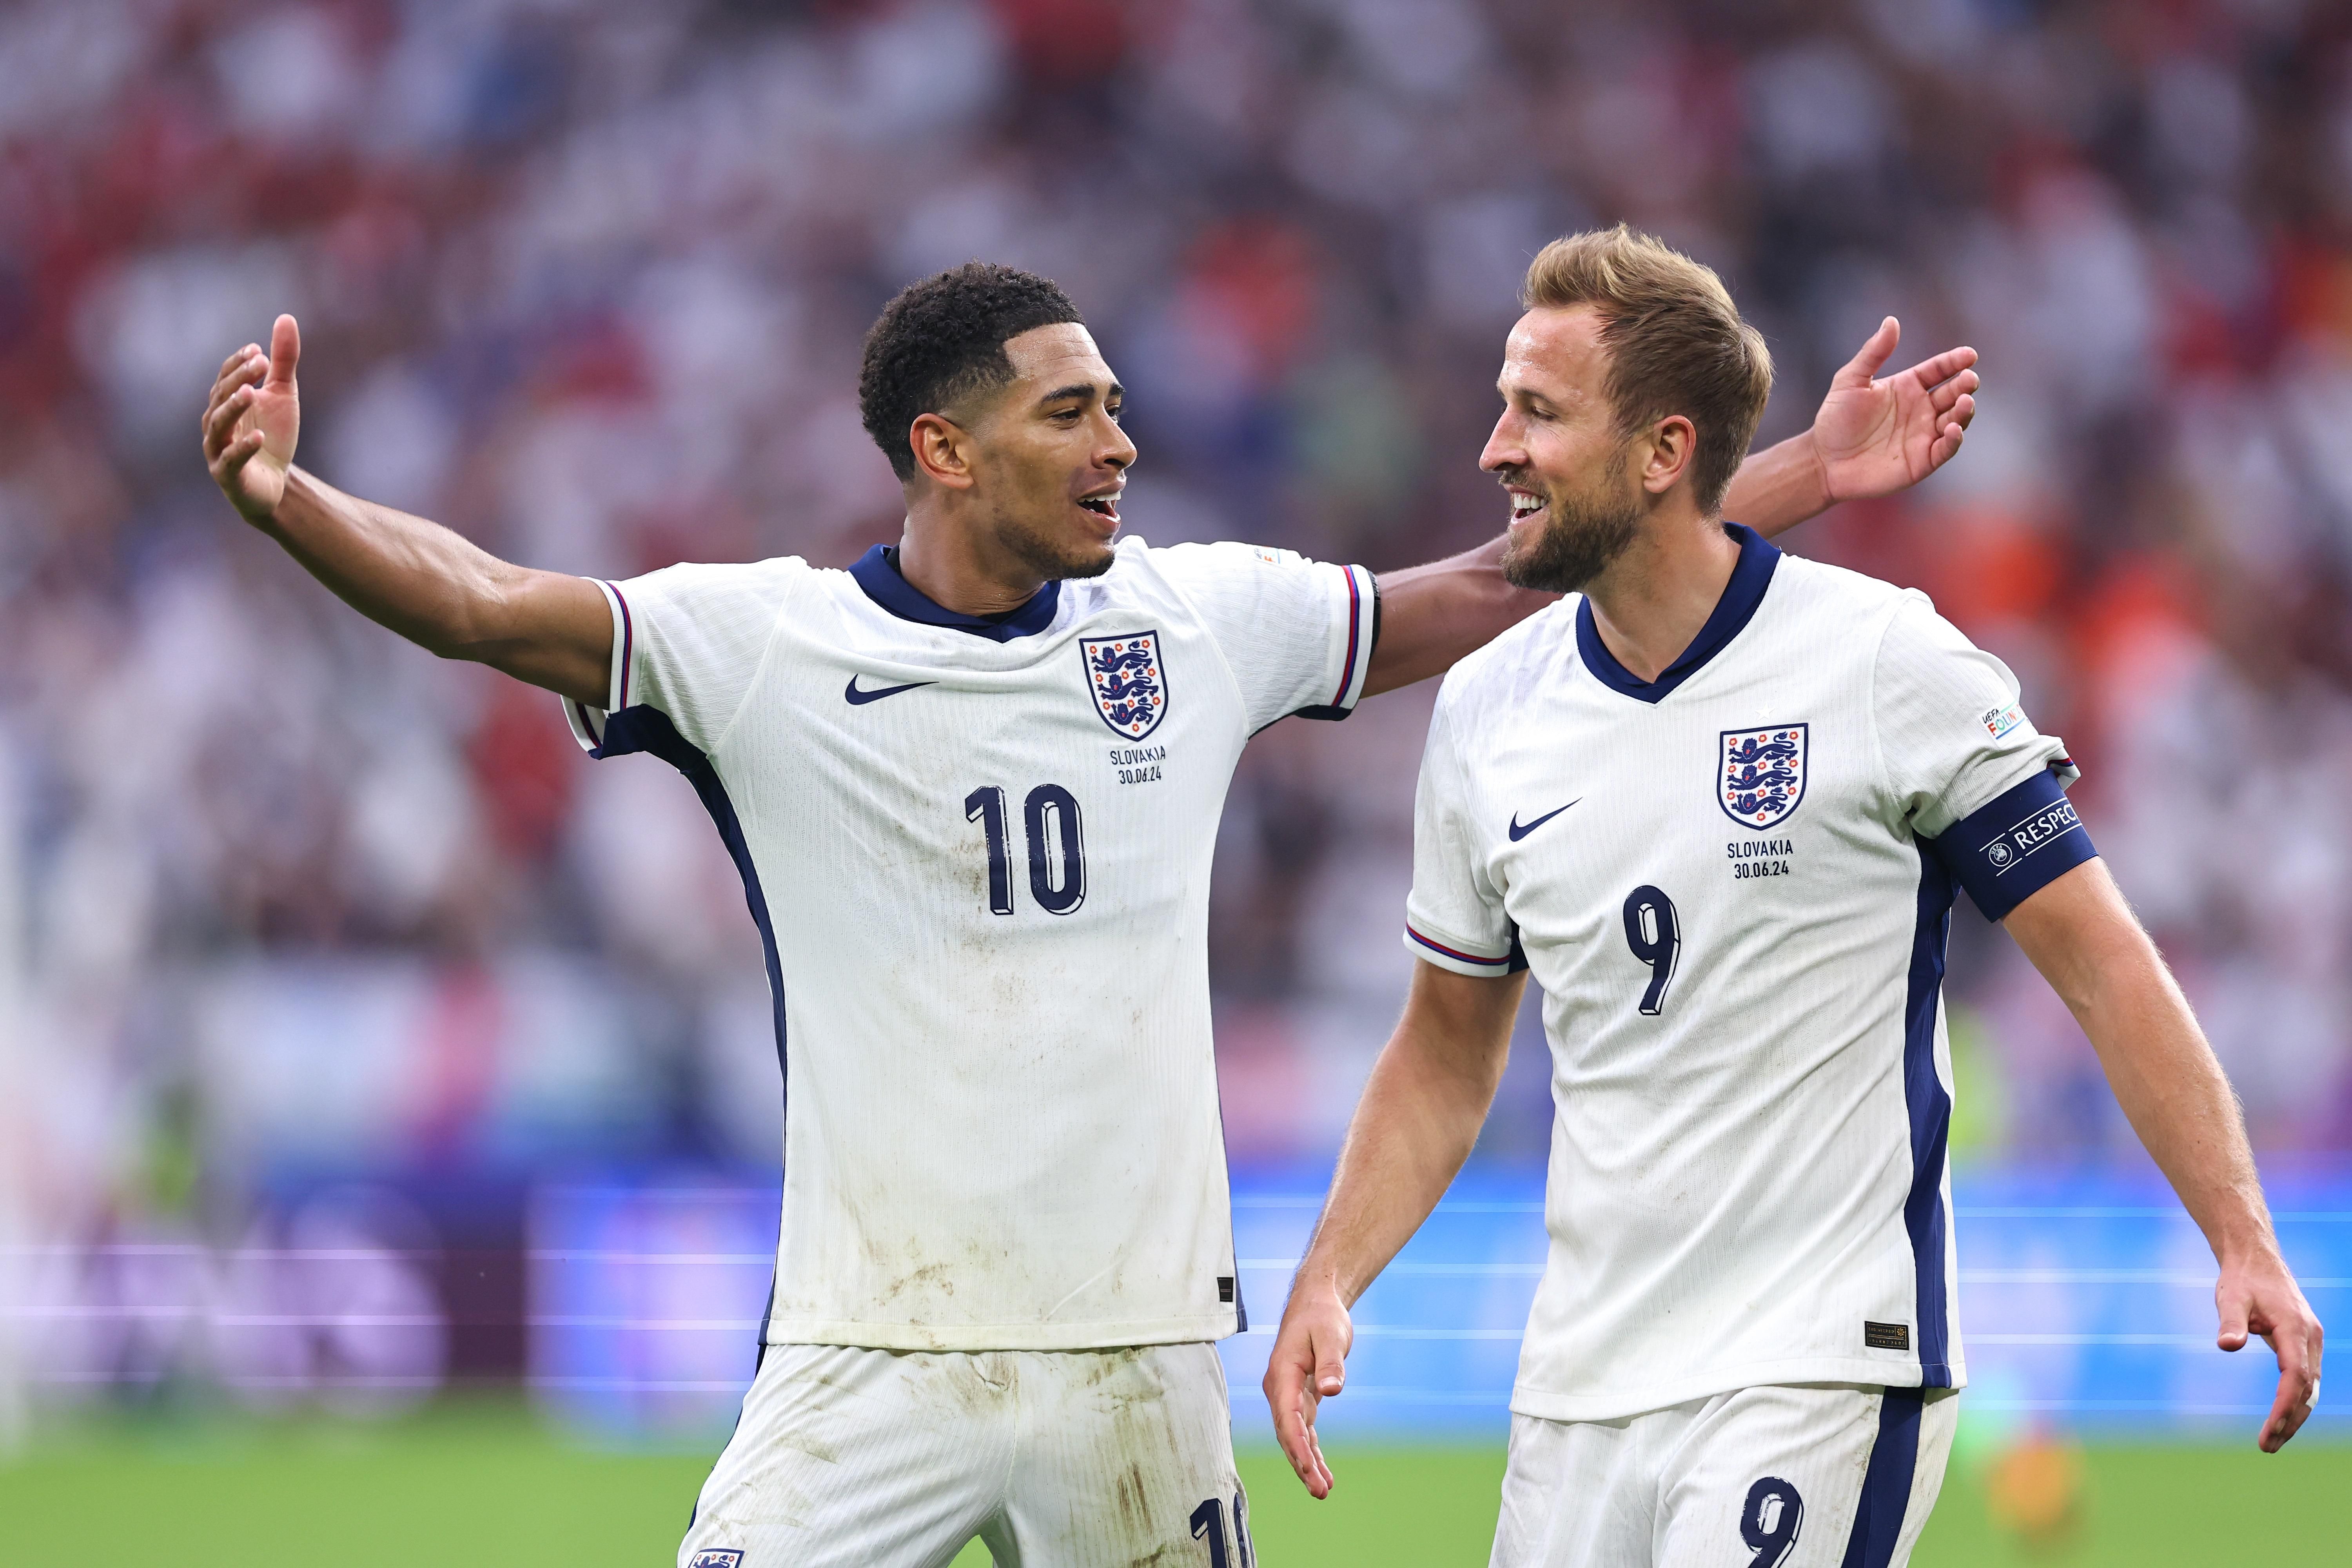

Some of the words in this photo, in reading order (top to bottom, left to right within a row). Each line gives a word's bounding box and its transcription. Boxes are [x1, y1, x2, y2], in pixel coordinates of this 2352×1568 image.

[1982, 708, 2000, 724] UEFA
[1110, 746, 1165, 765] SLOVAKIA
[1118, 766, 1161, 784] 30.06.24
[965, 784, 1086, 915] 10
[1728, 839, 1793, 858] SLOVAKIA
[1991, 845, 2002, 854] UEFA
[1734, 860, 1789, 879] 30.06.24
[1623, 885, 1681, 1015] 9
[1740, 1476, 1804, 1568] 9
